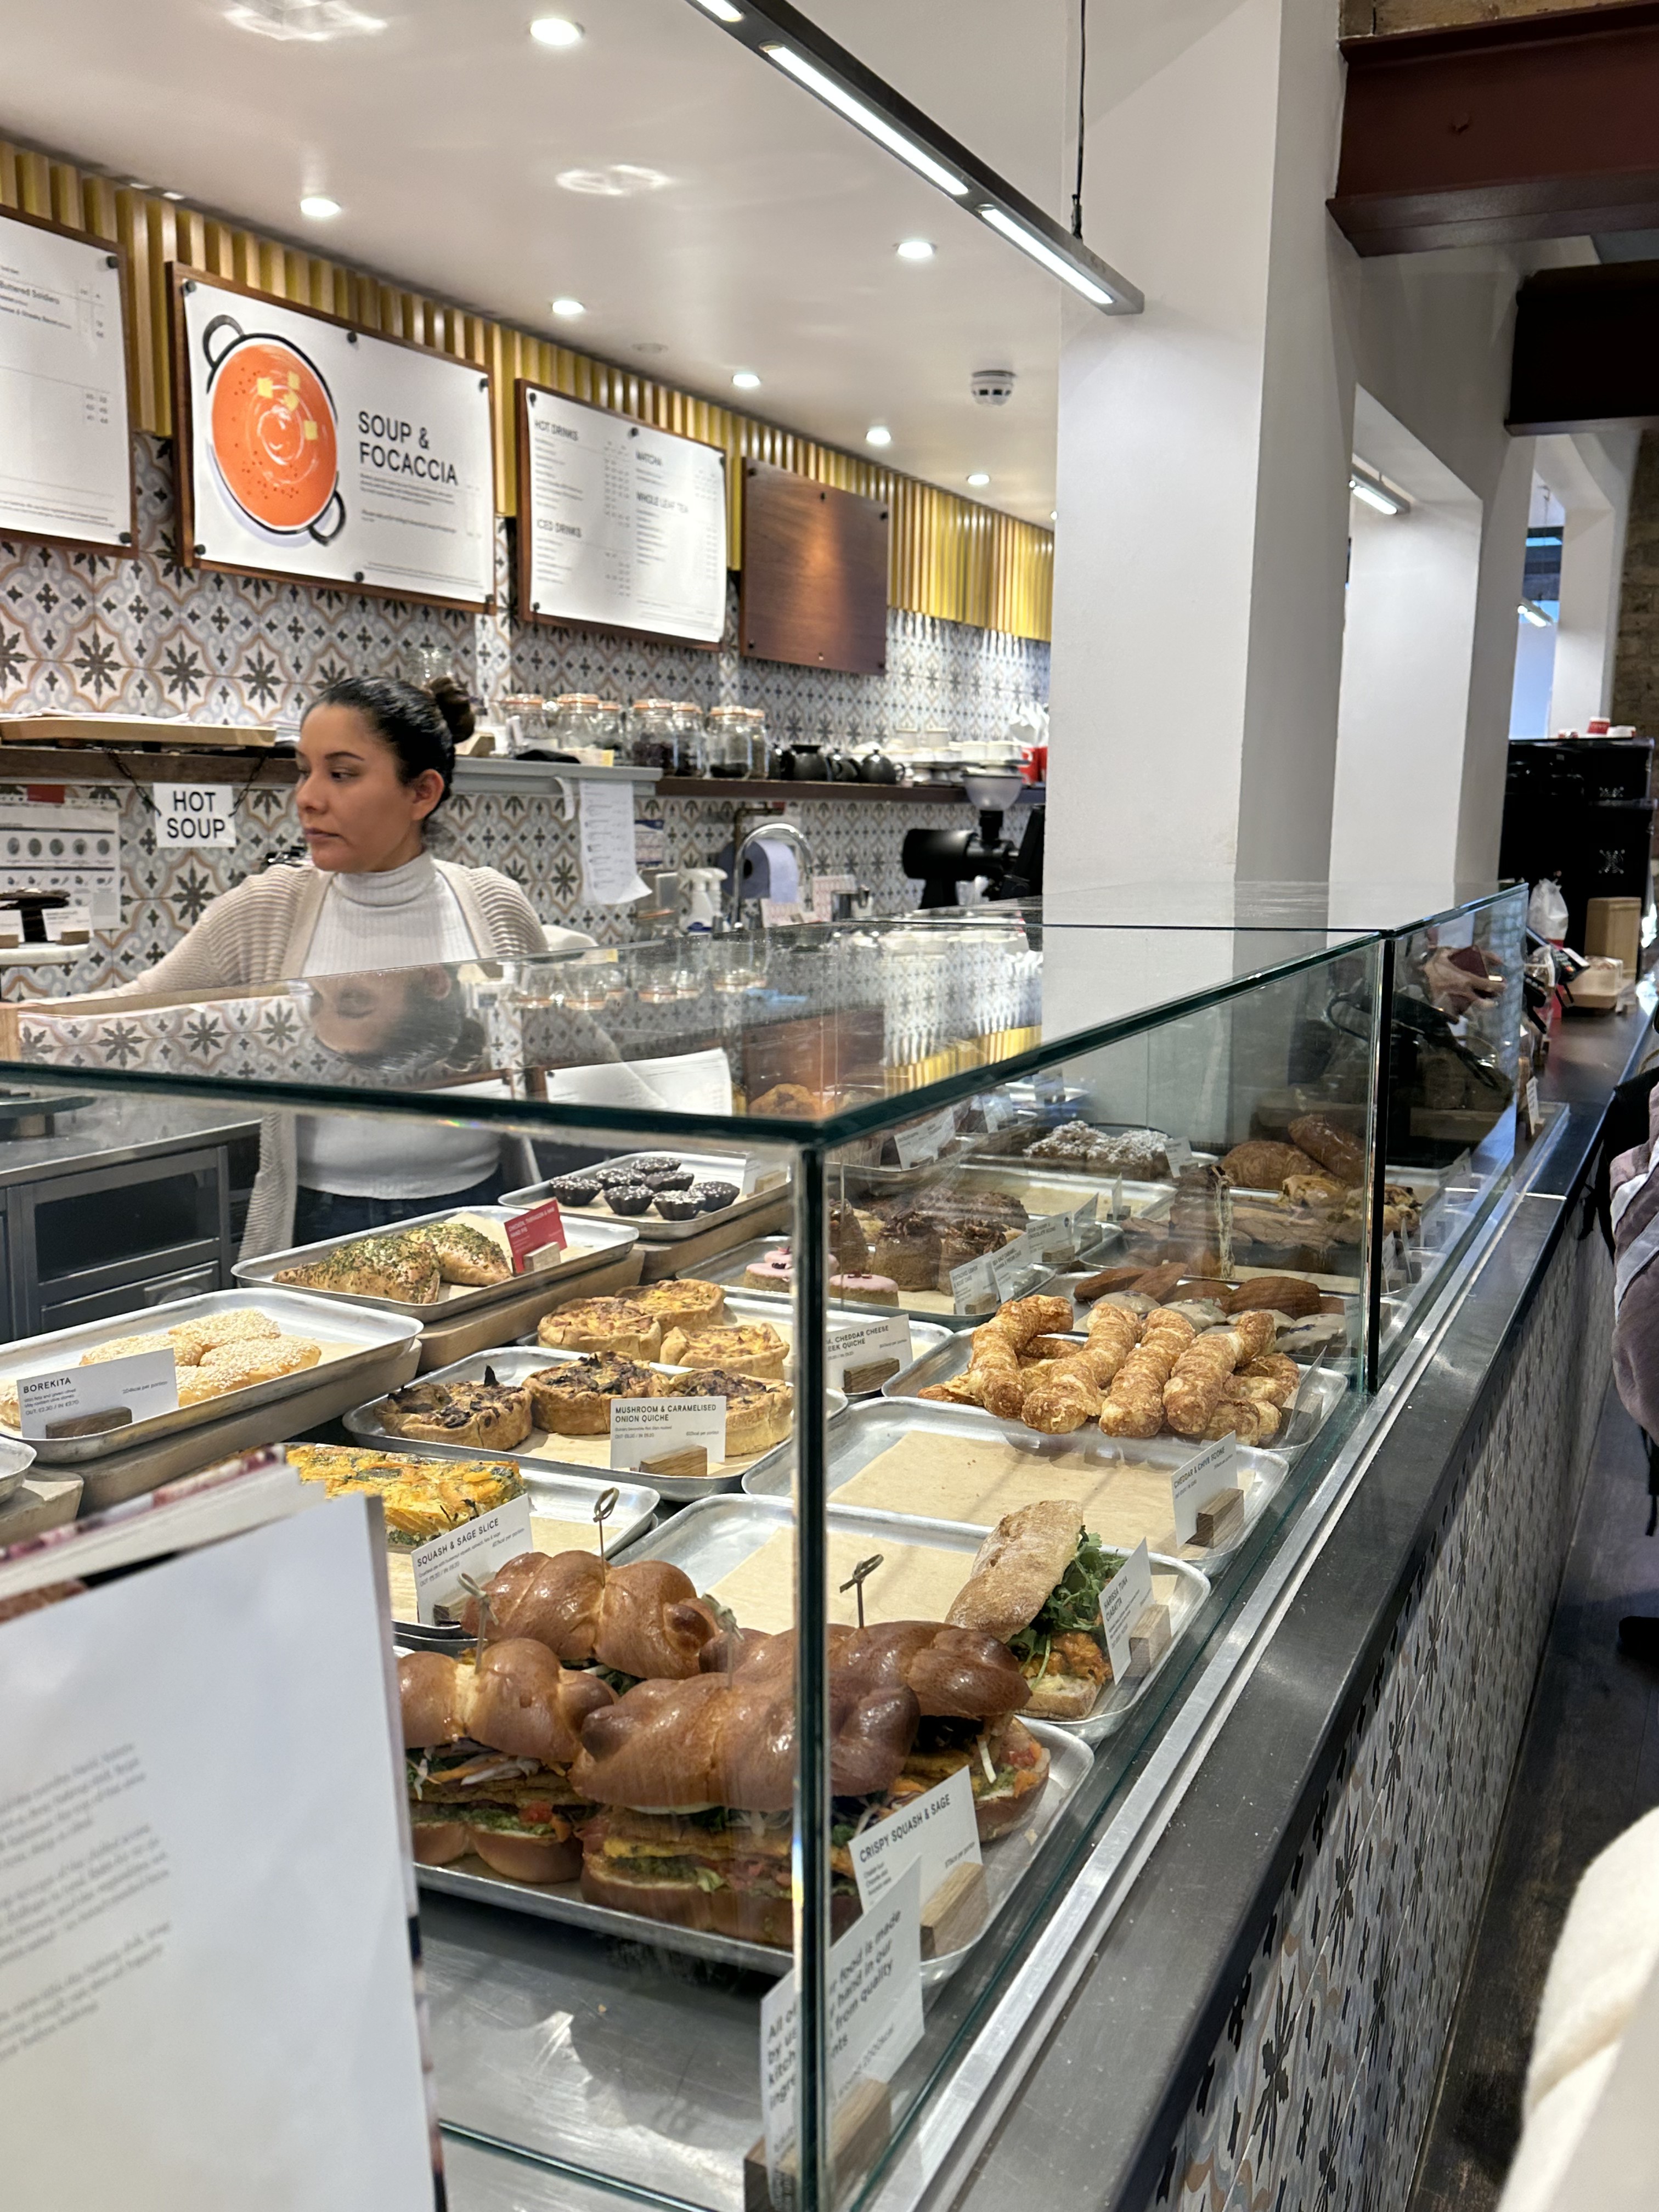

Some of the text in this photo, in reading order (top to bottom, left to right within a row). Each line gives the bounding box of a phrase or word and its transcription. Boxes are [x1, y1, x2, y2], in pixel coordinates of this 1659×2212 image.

[358, 410, 430, 450] SOUP &
[535, 420, 579, 441] HOT DRINKS
[360, 442, 459, 486] FOCACCIA
[537, 519, 582, 538] ICED DRINKS
[173, 791, 216, 812] HOT
[167, 817, 225, 839] SOUP
[835, 1331, 865, 1343] CHEDDAR
[866, 1325, 889, 1335] CHEESE
[842, 1338, 866, 1349] QUICHE
[23, 1377, 71, 1393] BOREKITA
[616, 1406, 658, 1414] MUSHROOM
[667, 1404, 716, 1412] CARAMELISED
[642, 1414, 669, 1423] QUICHE
[1174, 1469, 1193, 1489] CHEDDAR
[1194, 1466, 1197, 1474] &
[1198, 1456, 1210, 1470] CHIVE
[1211, 1446, 1225, 1461] SCONE
[417, 1517, 499, 1567] SQUASH & SAGE SLICE
[512, 1527, 524, 1537] portion
[1103, 1587, 1119, 1610] HARISSA
[1118, 1576, 1128, 1592] TUNA
[1105, 1596, 1122, 1622] CIABATTA
[859, 1793, 951, 1863] CRISPY SQUASH & SAGE
[768, 2016, 783, 2041] All
[840, 1948, 862, 1984] food
[865, 1940, 873, 1955] is
[876, 1910, 901, 1944] made
[769, 2044, 781, 2065] by
[838, 1970, 862, 2007] hand
[865, 1961, 873, 1976] in
[876, 1938, 892, 1962] our
[836, 1999, 858, 2030] from
[861, 1958, 893, 2001] quality
